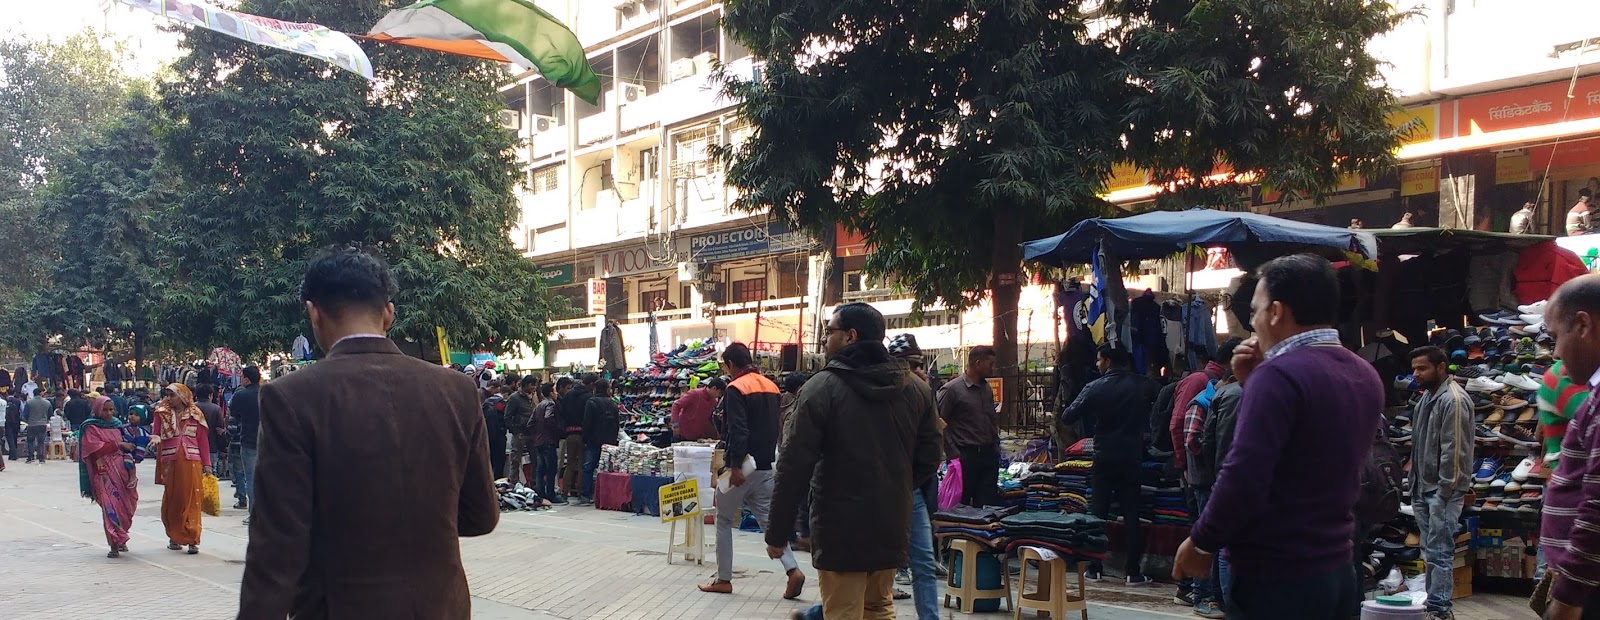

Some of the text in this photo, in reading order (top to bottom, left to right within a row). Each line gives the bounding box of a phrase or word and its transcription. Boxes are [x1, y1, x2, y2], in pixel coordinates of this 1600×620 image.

[1402, 172, 1434, 182] WELCOME
[1415, 183, 1424, 191] TO
[593, 281, 606, 294] BAR
